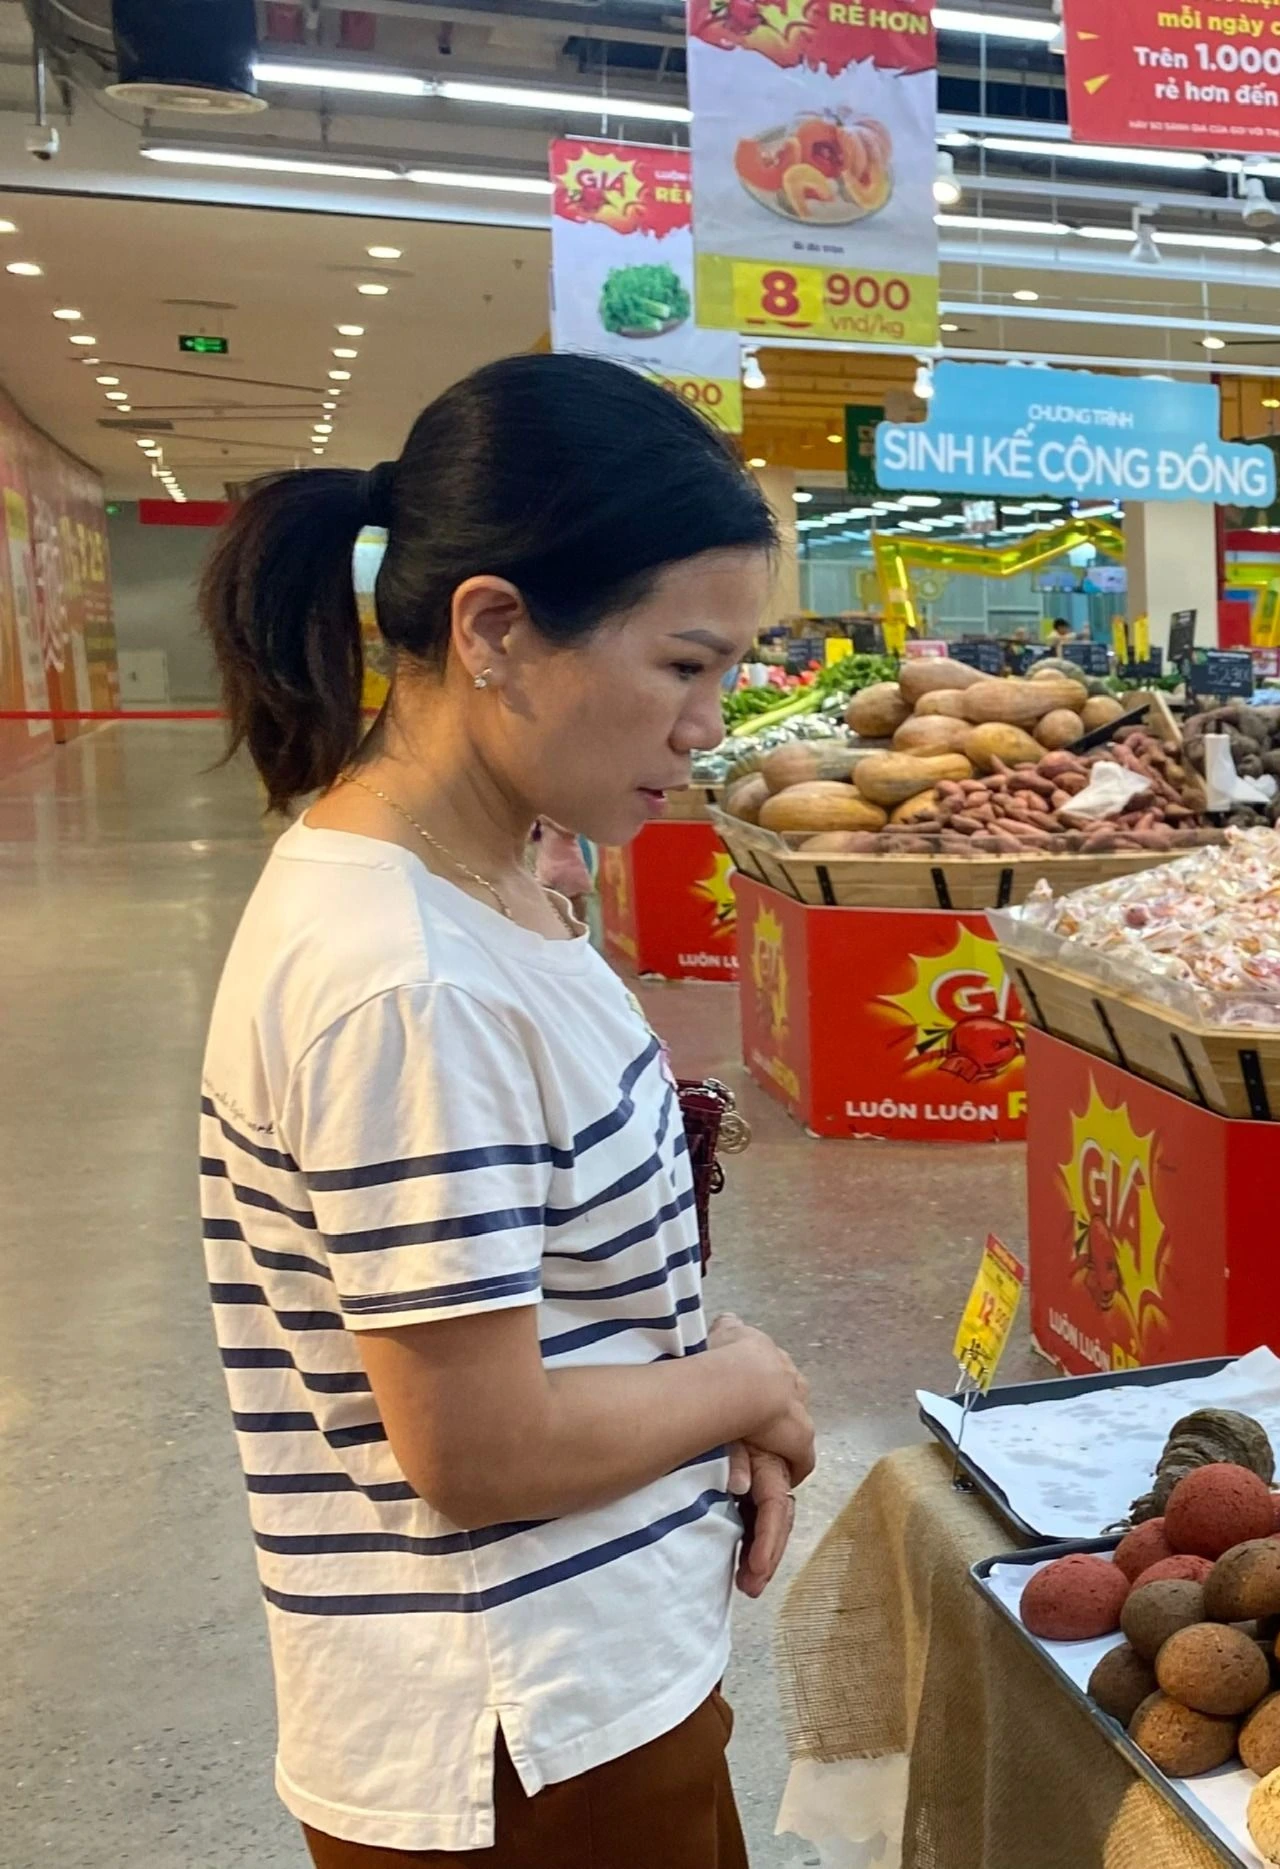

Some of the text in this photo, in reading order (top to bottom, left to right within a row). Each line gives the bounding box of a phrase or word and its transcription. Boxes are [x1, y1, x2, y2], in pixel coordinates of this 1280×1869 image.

[869, 9, 929, 35] HƠN
[1157, 5, 1202, 30] mỗi
[1208, 14, 1263, 37] ngày
[1133, 46, 1189, 69] Trên
[1155, 77, 1179, 99] rẻ
[1185, 81, 1229, 103] hơn
[1235, 82, 1278, 107] đến
[577, 169, 628, 197] GIÁ
[761, 270, 800, 316] 8
[830, 314, 905, 339] vnd/kg
[883, 423, 1267, 497] SINH KẾ CỘNG ĐỒNG
[678, 951, 721, 968] LUÔN
[845, 1098, 998, 1121] LUÔN LUÔN
[1081, 1138, 1147, 1275] GIÁ
[1049, 1307, 1078, 1347] LUÔN
